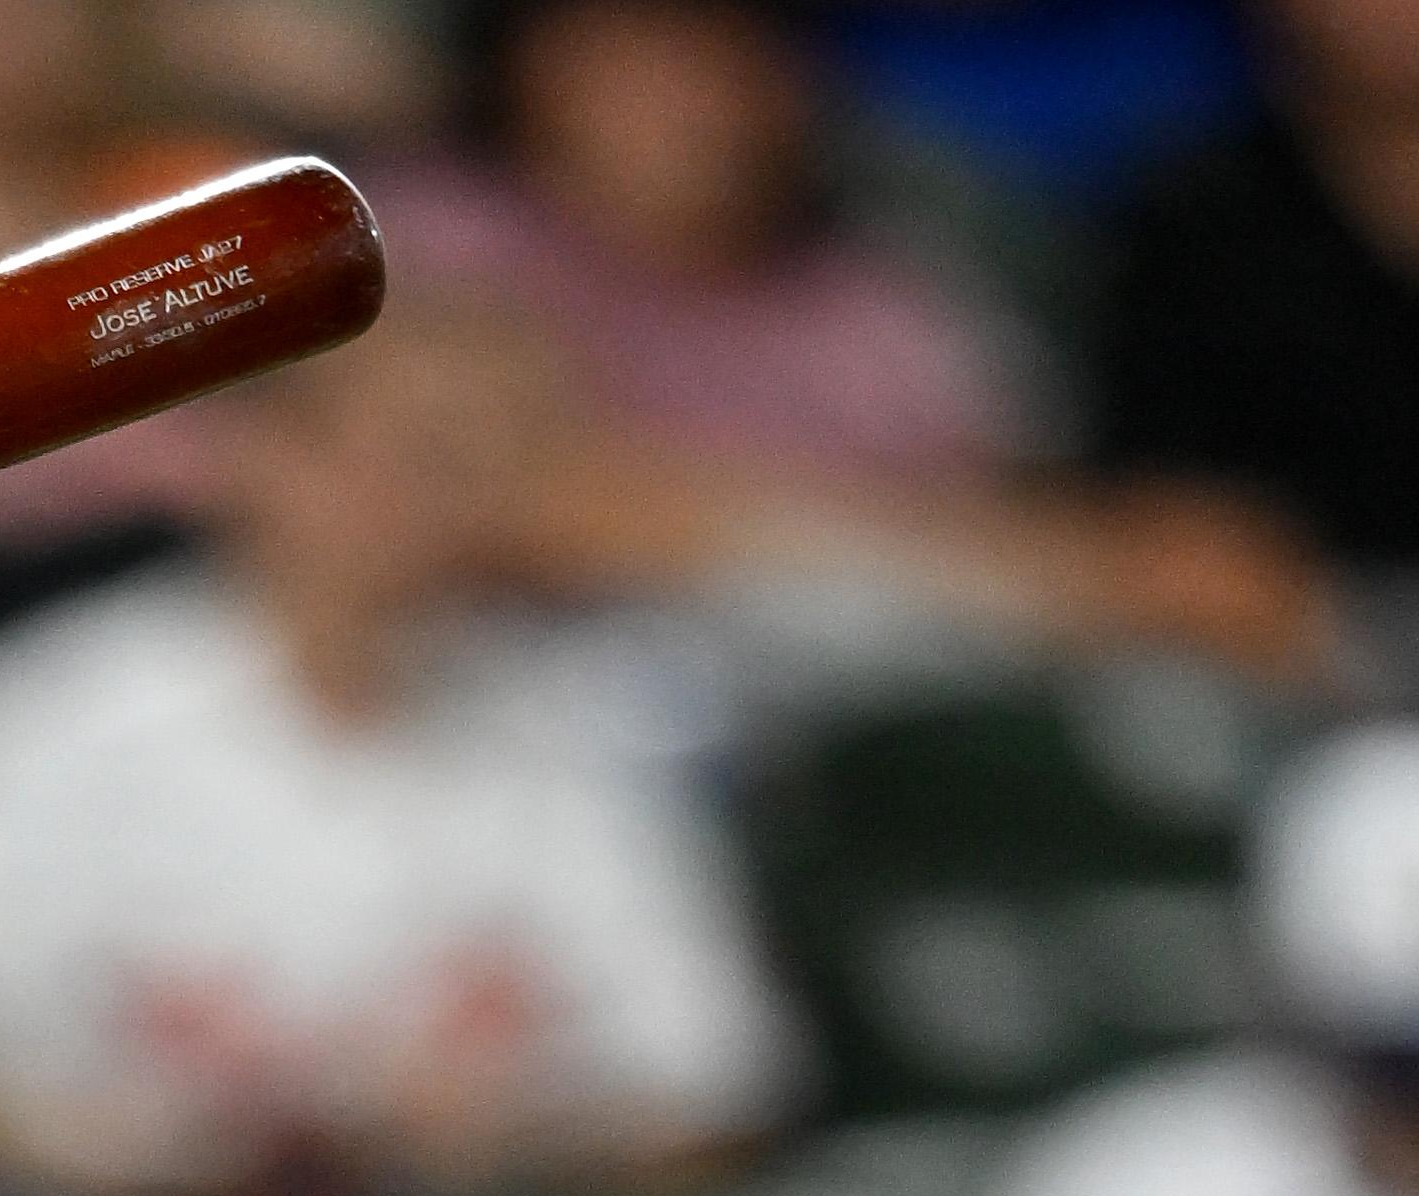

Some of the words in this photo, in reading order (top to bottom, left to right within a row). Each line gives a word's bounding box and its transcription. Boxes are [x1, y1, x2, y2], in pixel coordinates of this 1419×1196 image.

[67, 286, 109, 311] PRO
[110, 253, 196, 295] RESERVE
[164, 265, 255, 314] ALTUVE
